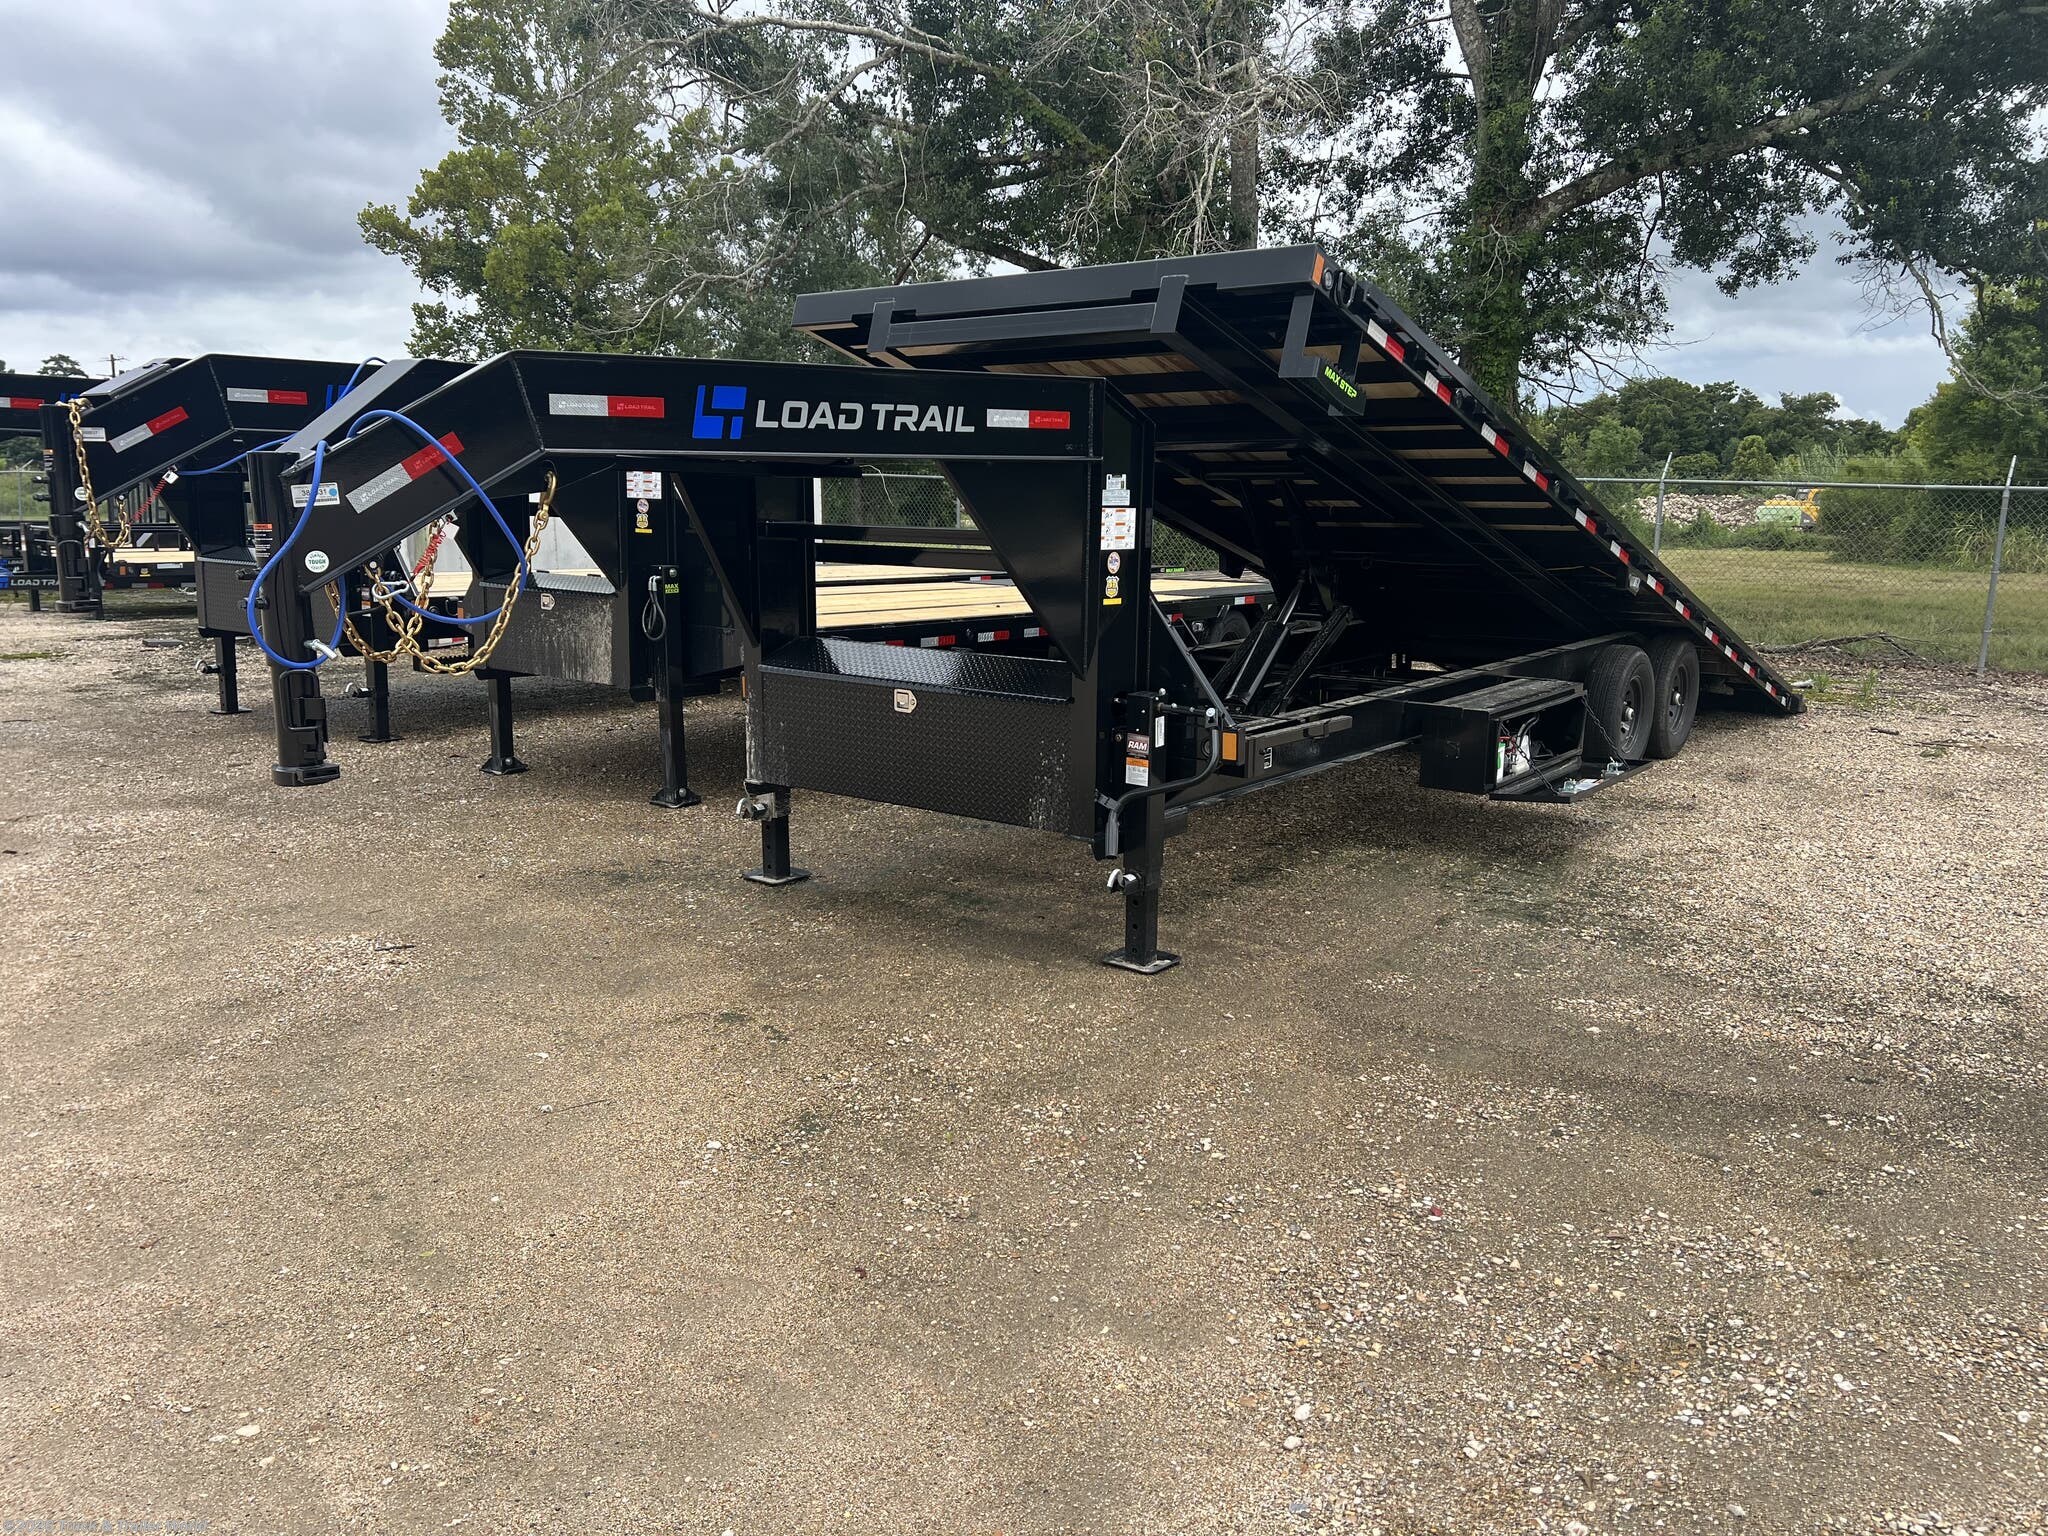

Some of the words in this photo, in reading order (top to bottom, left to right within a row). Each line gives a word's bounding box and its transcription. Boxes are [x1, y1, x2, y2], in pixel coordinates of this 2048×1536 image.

[1325, 366, 1341, 386] MAX
[1340, 379, 1358, 398] STEP
[755, 399, 864, 430] LOAD
[871, 403, 975, 432] TRAIL
[1128, 740, 1148, 752] RAM
